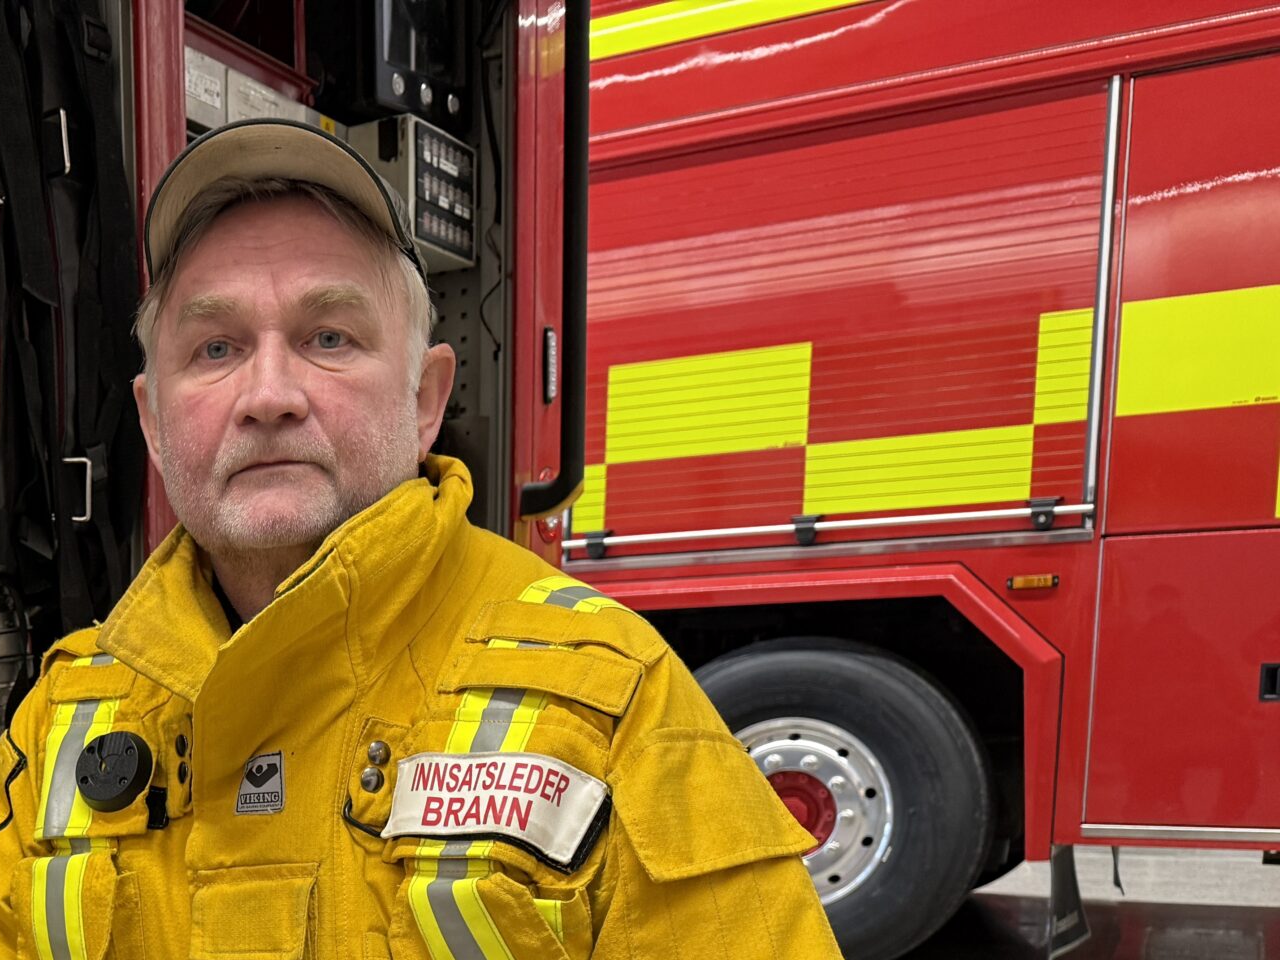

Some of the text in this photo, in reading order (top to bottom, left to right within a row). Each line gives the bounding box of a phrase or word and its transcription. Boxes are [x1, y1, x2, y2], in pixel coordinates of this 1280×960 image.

[240, 792, 279, 804] VIKING
[410, 761, 570, 807] INNSATSLEDER
[420, 795, 534, 831] BRANN
